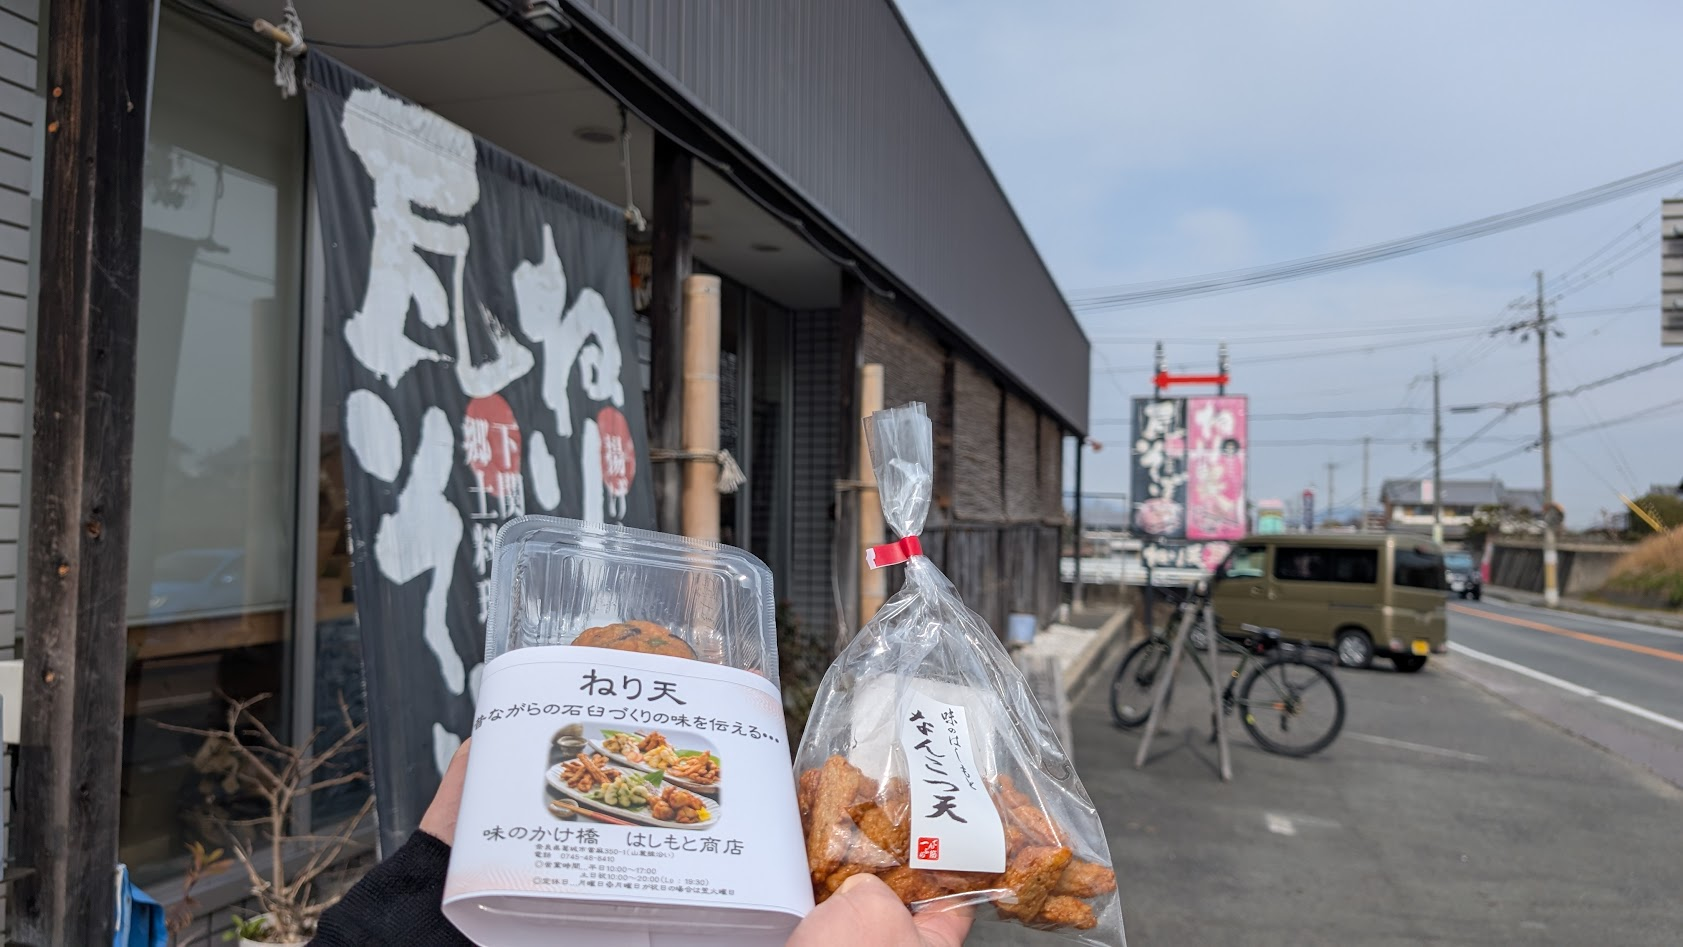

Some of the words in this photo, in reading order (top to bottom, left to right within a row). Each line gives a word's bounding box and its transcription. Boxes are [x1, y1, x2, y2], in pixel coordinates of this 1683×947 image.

[342, 87, 535, 775] 瓦そ
[579, 669, 687, 705] ねり天
[909, 710, 968, 823] なんこつ天
[941, 708, 977, 790] 味のはしもと
[483, 825, 600, 845] 味のかけ橋
[626, 832, 744, 855] はしもと商店
